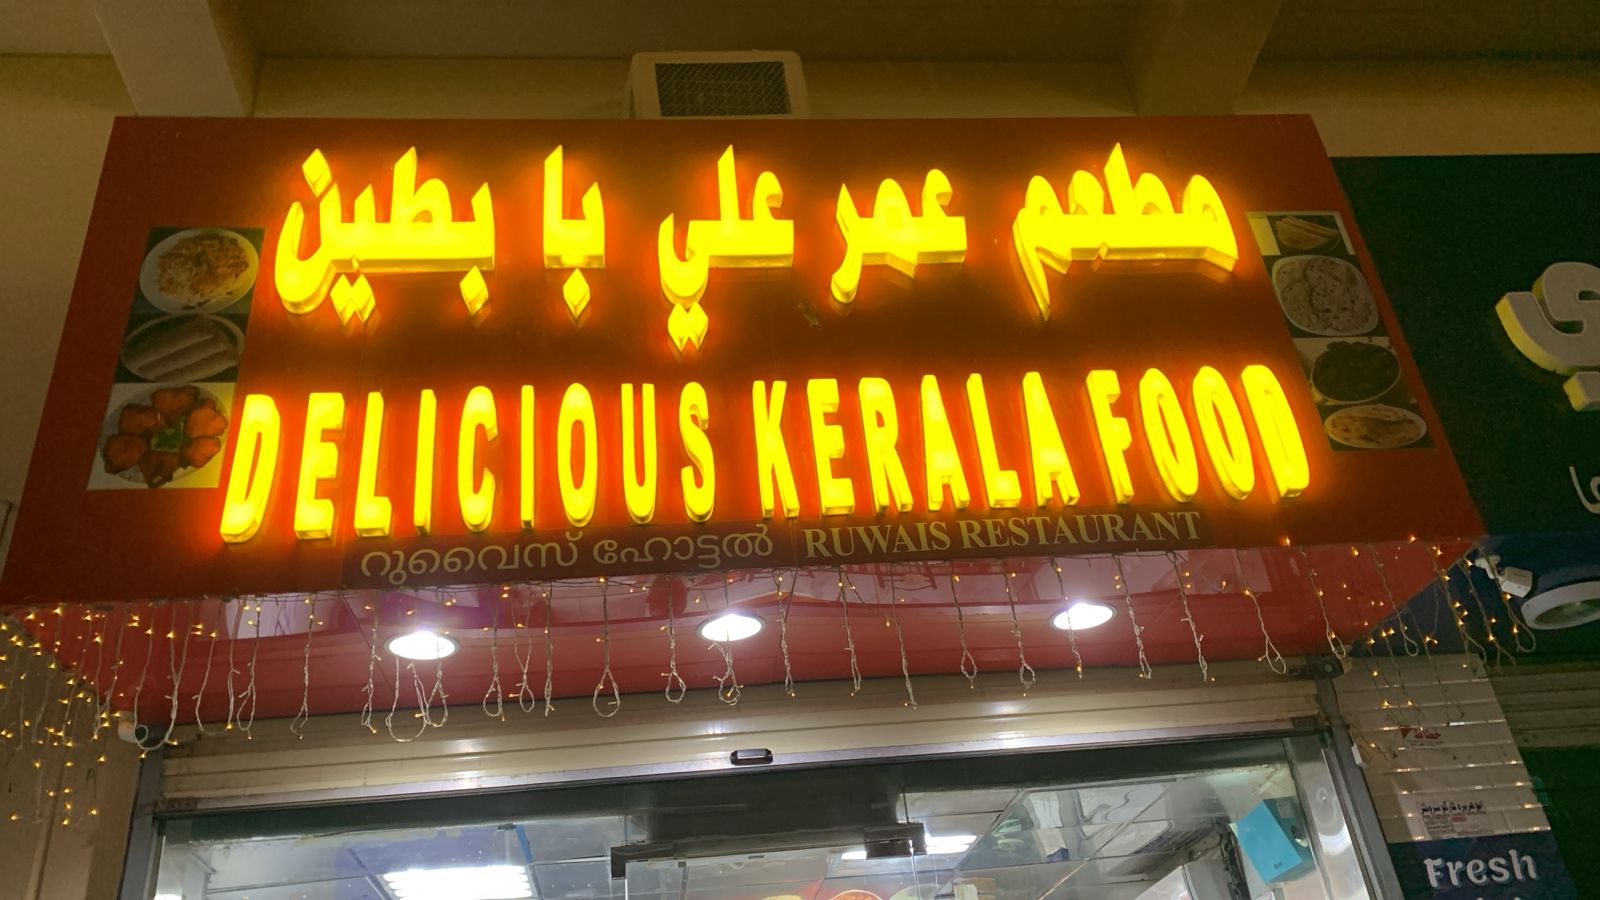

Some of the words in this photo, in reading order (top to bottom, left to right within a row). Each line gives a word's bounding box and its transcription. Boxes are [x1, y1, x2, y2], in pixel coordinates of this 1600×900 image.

[274, 146, 495, 326] بطين
[543, 145, 605, 319] با
[658, 144, 794, 352] علي
[831, 168, 967, 304] عمر
[1012, 142, 1238, 321] مطعم
[219, 382, 715, 543] DELICIOUS
[752, 371, 1080, 518] KERALA
[1086, 364, 1311, 504] FOOD
[802, 521, 952, 558] RUWAIS
[957, 511, 1201, 549] RESTAURANT
[360, 531, 583, 584] റുവൈസ്
[593, 523, 773, 569] ഹോട്ടൽ
[1424, 849, 1538, 888] Fresh
